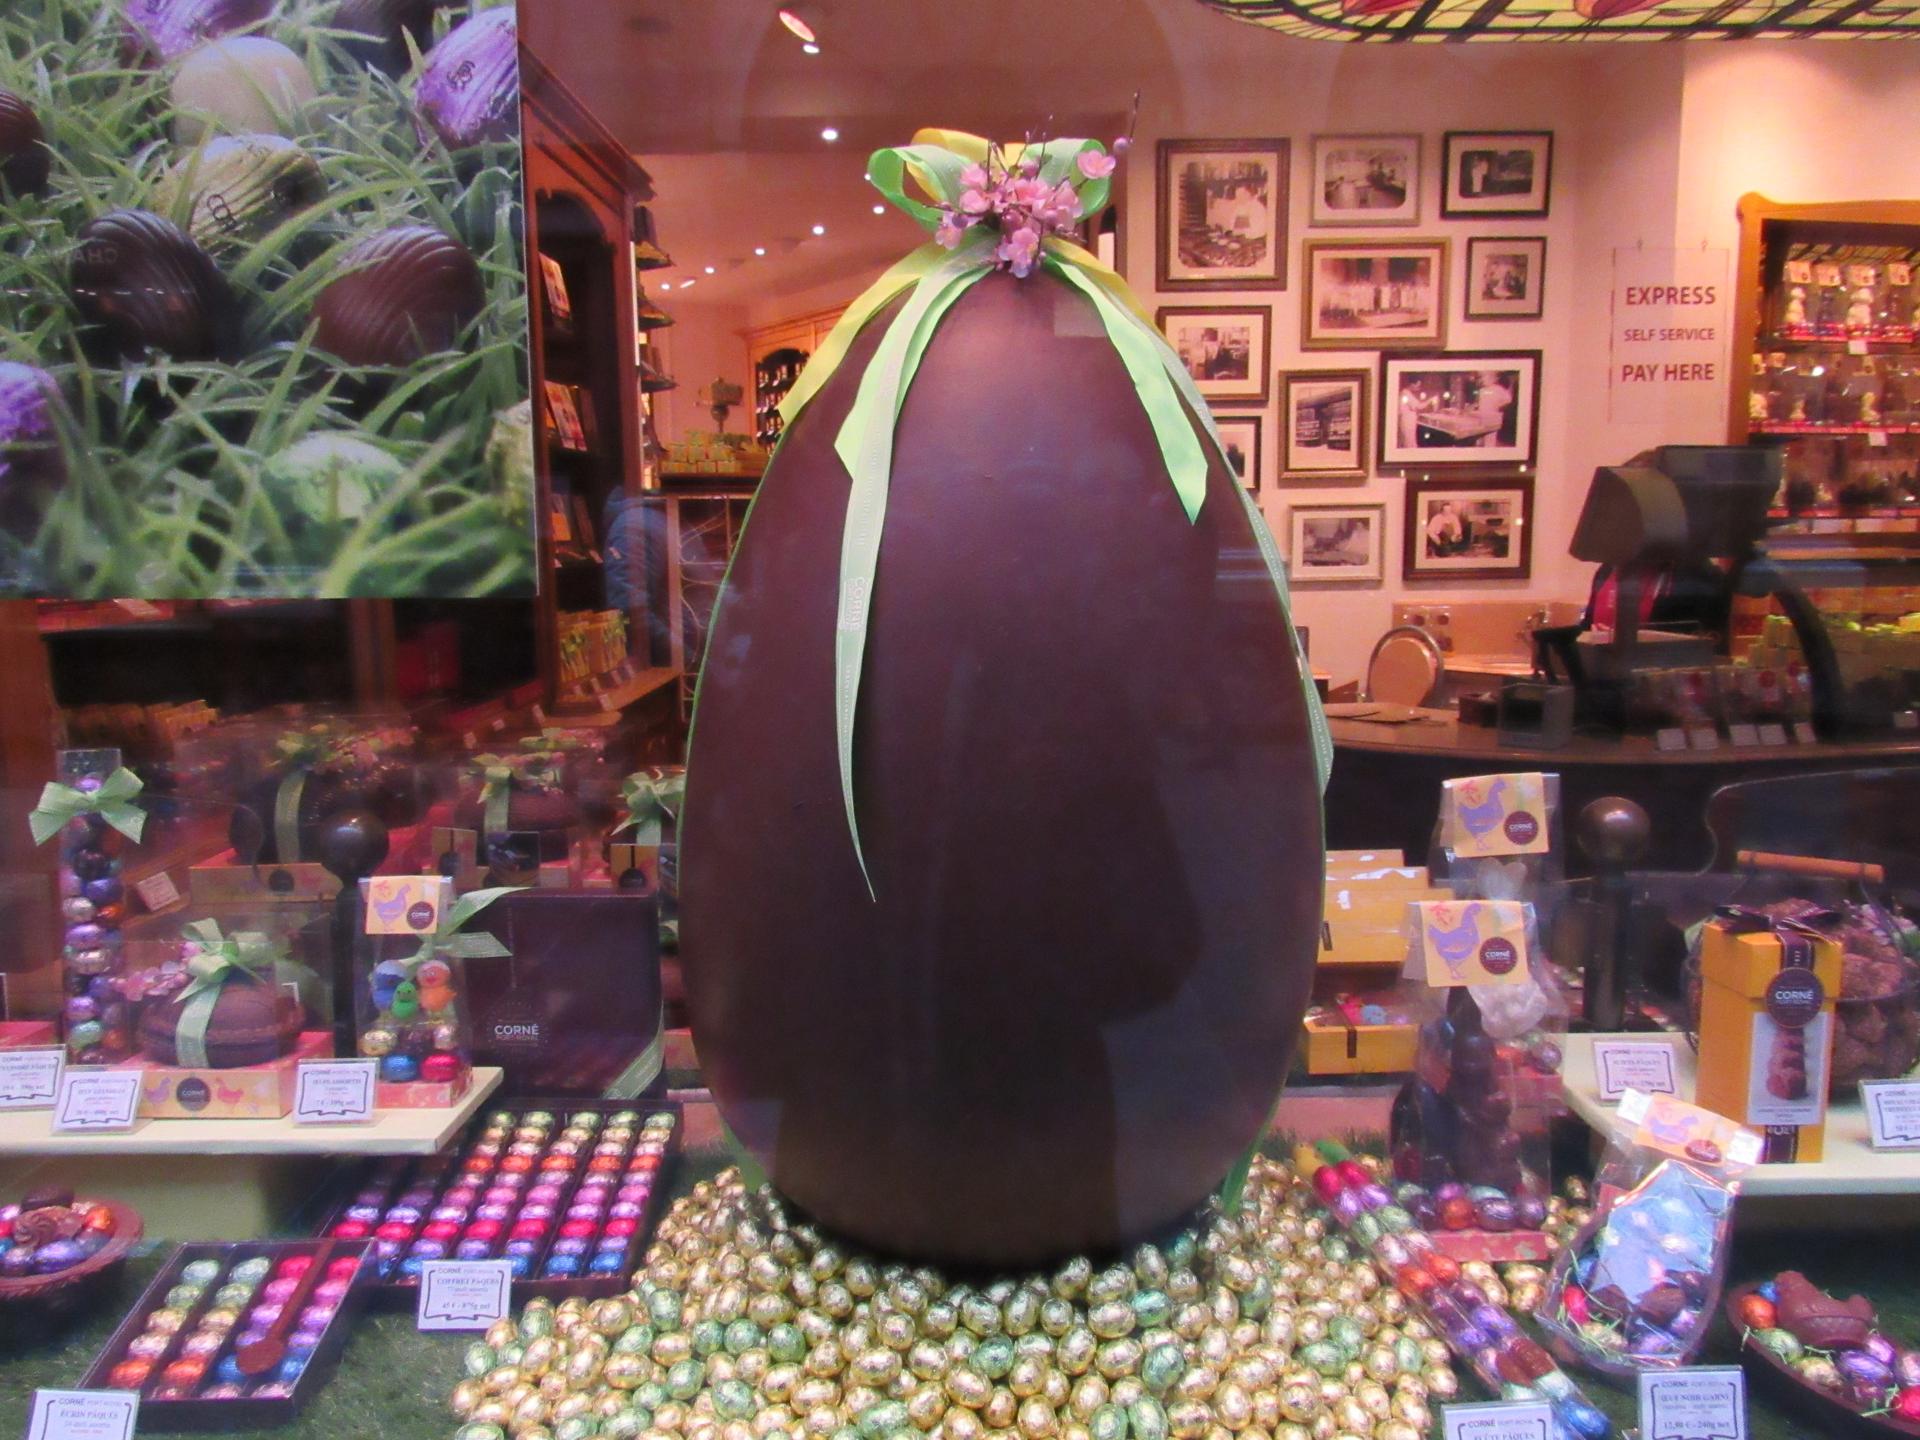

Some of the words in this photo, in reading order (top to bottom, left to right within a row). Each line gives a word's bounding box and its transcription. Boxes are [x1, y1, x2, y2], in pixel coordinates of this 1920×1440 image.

[1626, 286, 1716, 306] EXPRESS
[1624, 329, 1657, 342] SELF
[1659, 328, 1715, 341] SERVICE
[1622, 364, 1658, 382] PAY
[1664, 363, 1715, 381] HERE
[1775, 989, 1814, 1000] CORNÉ
[494, 1023, 539, 1035] CORNÉ
[58, 1398, 85, 1406] CORNÉ
[1467, 1418, 1496, 1428] CORNÉ
